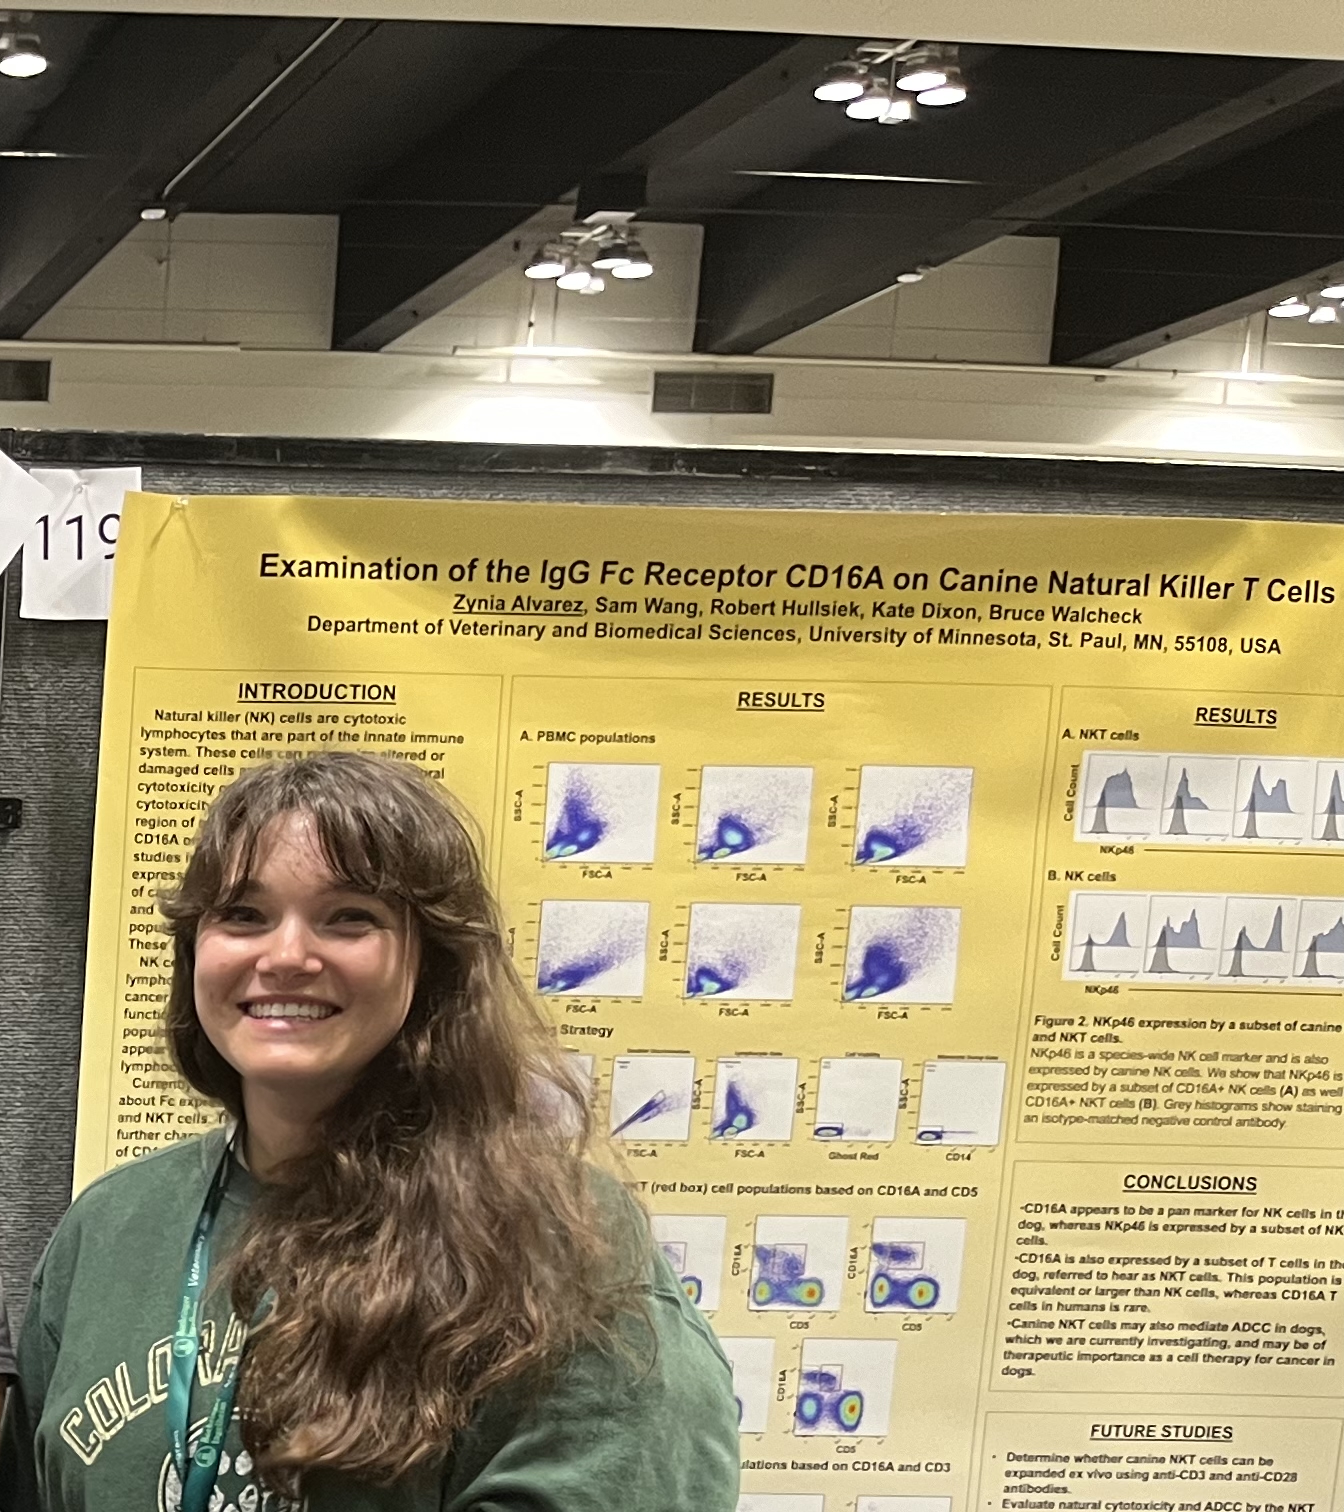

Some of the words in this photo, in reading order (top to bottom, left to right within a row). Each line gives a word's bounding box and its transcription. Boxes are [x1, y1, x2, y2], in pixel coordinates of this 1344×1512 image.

[35, 513, 121, 561] 119
[259, 552, 438, 582] Examination
[448, 557, 480, 582] of
[486, 558, 530, 584] the
[540, 559, 590, 591] IgG
[600, 560, 635, 585] Fc
[644, 561, 778, 593] Receptor
[786, 563, 884, 590] CD16A
[893, 572, 929, 591] on
[939, 567, 1038, 594] Canine
[1048, 570, 1151, 597] Natural
[1159, 573, 1235, 600] Killer
[1242, 576, 1260, 601] T
[1267, 578, 1335, 604] Cells
[453, 593, 510, 616] Zynia
[511, 595, 588, 615] Alvarez,
[595, 596, 637, 614] Sam
[644, 597, 703, 618] Wang,
[710, 598, 776, 616] Robert
[782, 599, 865, 620] Hullsiek,
[871, 601, 915, 618] Kate
[921, 602, 982, 623] Dixon,
[989, 603, 1045, 622] Bruce
[1051, 605, 1142, 625] Walcheck
[307, 615, 419, 636] Department
[424, 618, 445, 635] of
[449, 619, 546, 640] Veterinary
[552, 621, 589, 638] and
[594, 622, 702, 640] Biomedical
[708, 623, 802, 644] Sciences,
[809, 625, 908, 648] University
[913, 628, 934, 644] of
[938, 628, 1042, 650] Minnesota,
[1048, 631, 1073, 648] St.
[1080, 631, 1127, 652] Paul,
[1133, 633, 1168, 654] MN,
[1174, 635, 1233, 656] 55108,
[1240, 637, 1282, 655] USA
[238, 683, 396, 701] INTRODUCTION
[738, 691, 825, 708] RESULTS
[154, 708, 203, 722] Natural
[207, 710, 241, 723] killer
[244, 711, 275, 726] (NK)
[279, 711, 313, 724] cells
[316, 714, 339, 724] are
[343, 713, 406, 727] cytotoxic
[1195, 708, 1278, 725] RESULTS
[1123, 1175, 1257, 1192] CONCLUSIONS
[1090, 1424, 1157, 1438] FUTURE
[1161, 1424, 1233, 1439] STUDIES
